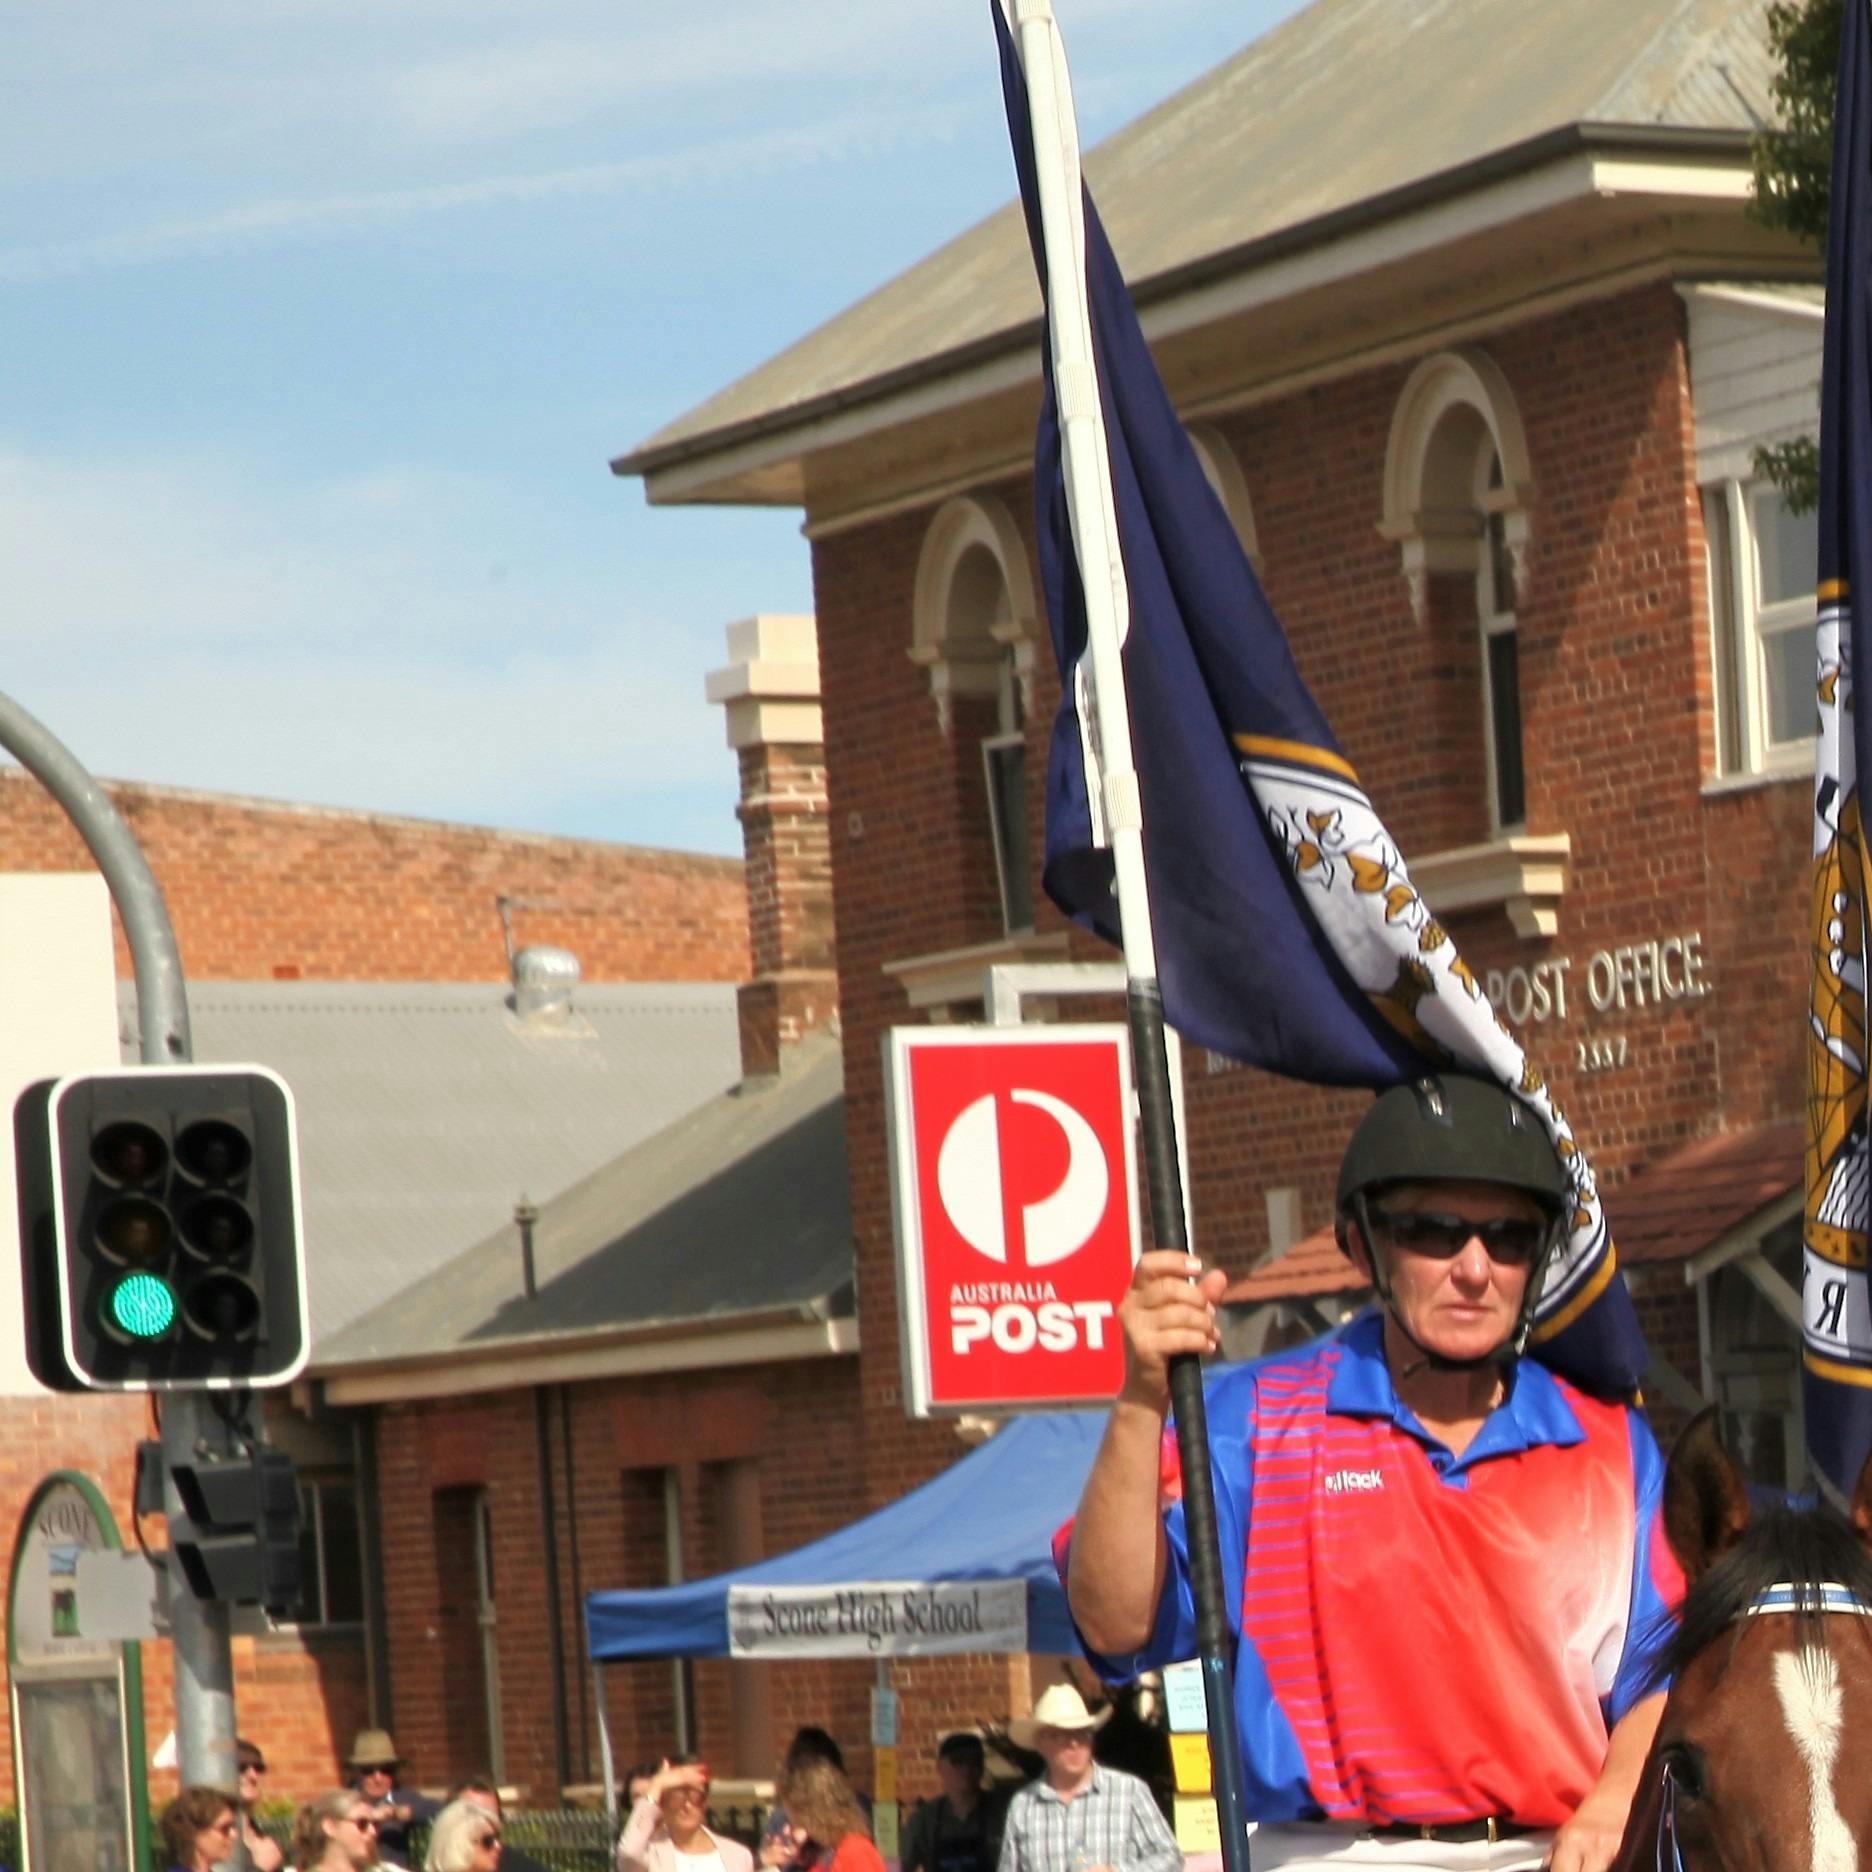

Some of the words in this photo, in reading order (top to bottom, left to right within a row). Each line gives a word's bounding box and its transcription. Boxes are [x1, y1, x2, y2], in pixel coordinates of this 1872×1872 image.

[1486, 957, 1572, 1026] POST
[950, 1281, 1057, 1304] AUSTRALIA
[950, 1301, 1114, 1355] POST
[762, 1594, 828, 1636] Scone
[836, 1590, 896, 1651] High
[901, 1590, 984, 1635] School
